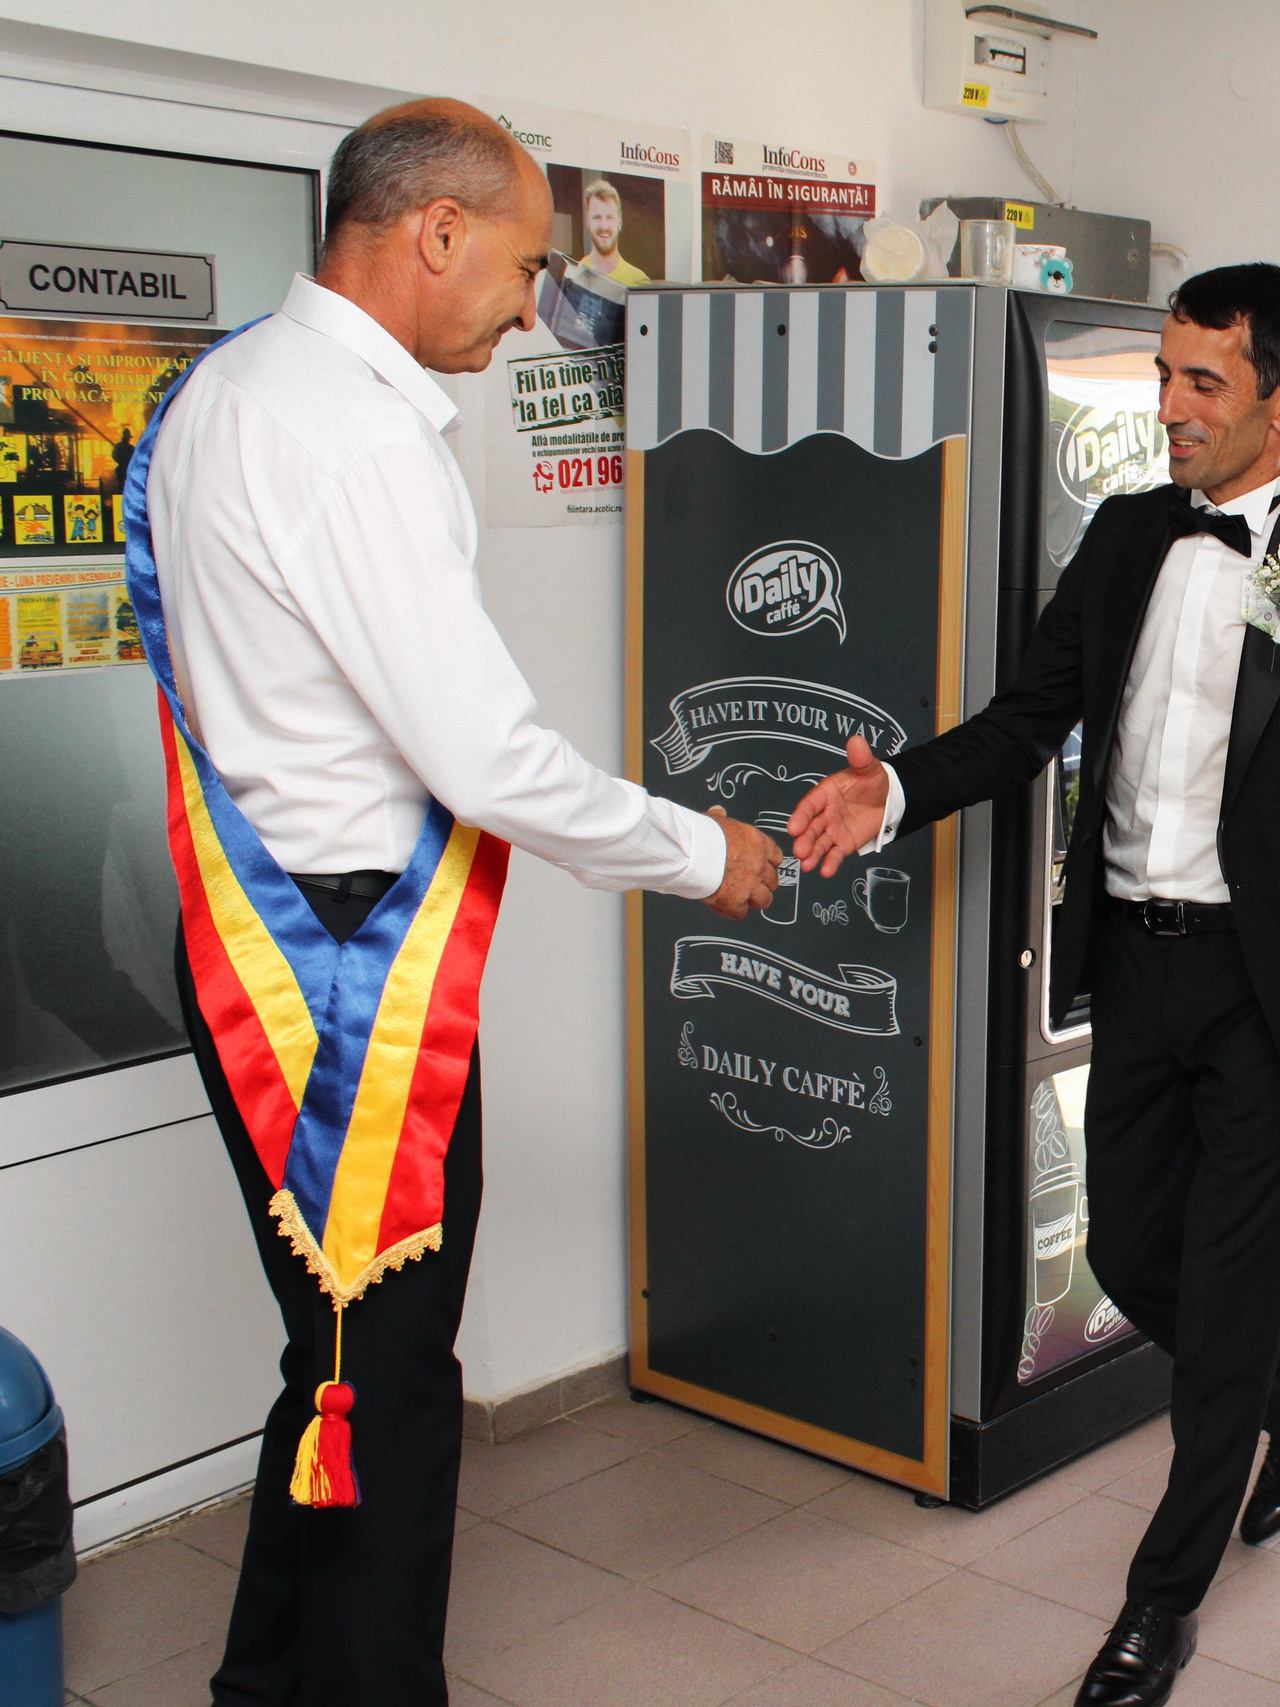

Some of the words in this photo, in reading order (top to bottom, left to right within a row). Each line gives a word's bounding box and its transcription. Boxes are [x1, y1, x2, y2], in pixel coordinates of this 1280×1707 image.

[963, 87, 974, 100] 220
[974, 89, 980, 100] V
[620, 141, 680, 167] InfoCons
[762, 144, 825, 172] InfoCons
[711, 175, 763, 199] RĂMÂI
[767, 179, 783, 200] ÎN
[1006, 208, 1017, 221] 220
[1017, 210, 1023, 222] V
[29, 264, 187, 300] CONTABIL
[63, 370, 160, 387] GOSPODĂRIE
[516, 369, 537, 394] Fii
[539, 368, 557, 390] la
[22, 387, 109, 403] PROVOACĂ
[519, 400, 537, 422] la
[542, 393, 566, 418] fel
[571, 393, 593, 413] ca
[600, 431, 611, 442] de
[1076, 410, 1158, 482] Daily
[558, 457, 593, 488] 021
[597, 455, 623, 485] 96
[16, 575, 35, 588] LUNA
[37, 573, 76, 586] PREVENIRII
[79, 571, 122, 583] INCENDIILOR
[741, 555, 820, 615] Daily
[689, 700, 744, 729] HAVE
[747, 700, 768, 721] IT
[772, 701, 829, 732] YOUR
[835, 712, 885, 749] WAY
[720, 952, 782, 990] HAVE
[788, 974, 851, 1018] YOUR
[702, 1044, 777, 1087] DAILY
[782, 1065, 866, 1110] CAFFÈ
[1037, 1227, 1073, 1250] COFFEE
